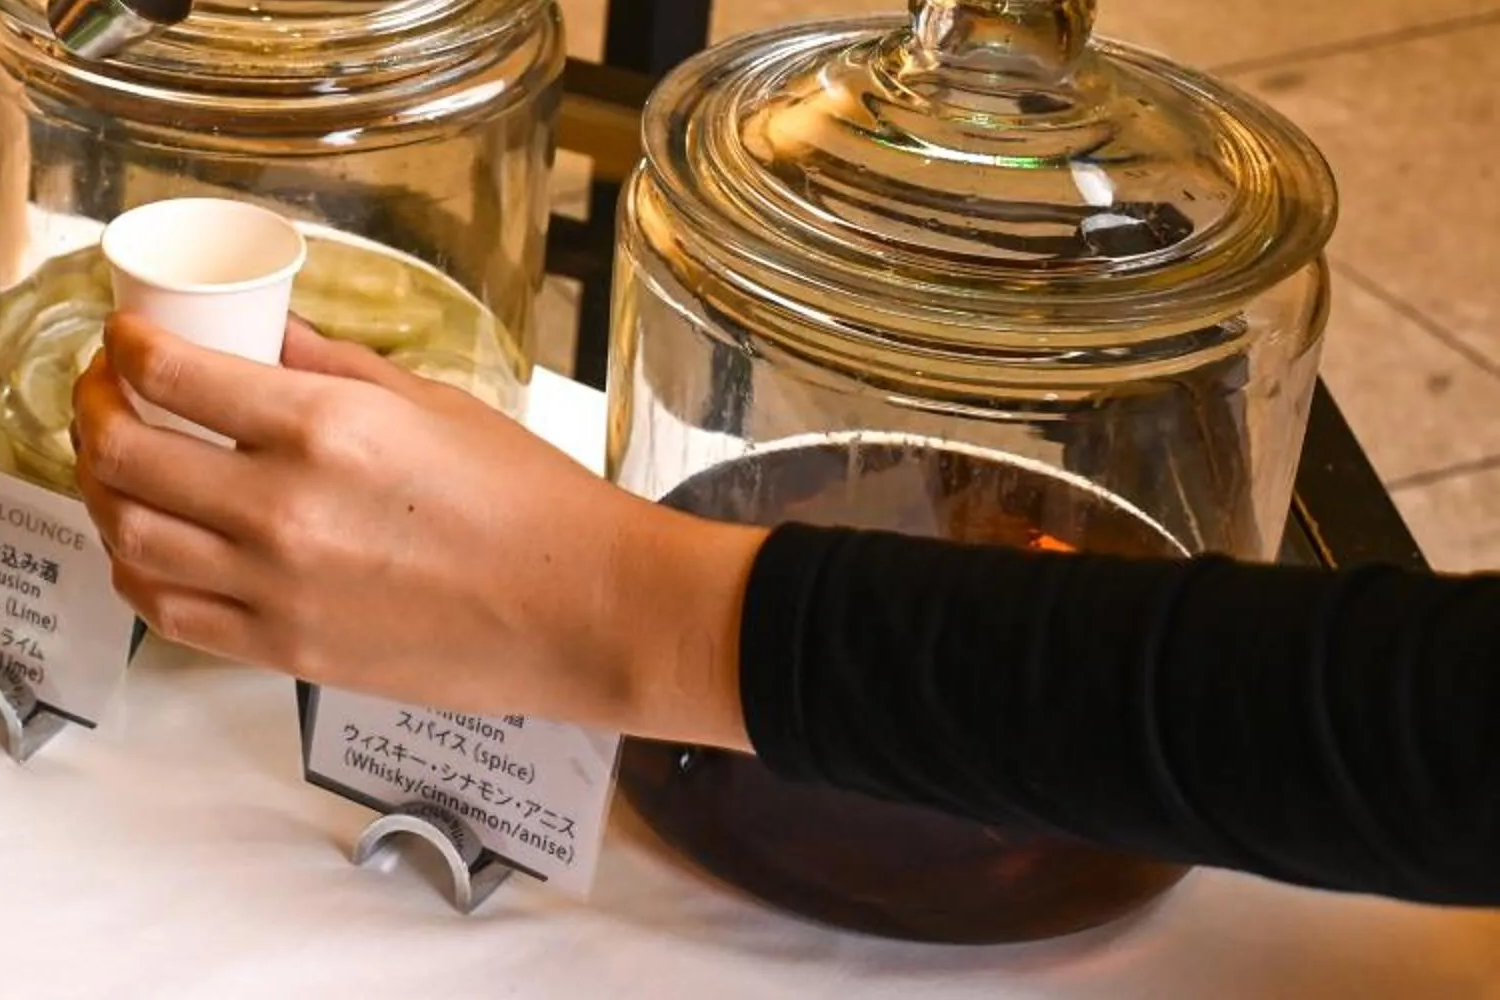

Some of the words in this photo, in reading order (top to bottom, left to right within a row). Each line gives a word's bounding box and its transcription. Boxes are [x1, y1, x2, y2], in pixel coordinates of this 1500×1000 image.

[5, 597, 57, 633] (Lime)
[395, 710, 466, 755] スパイス
[473, 742, 535, 784] (spice)
[426, 707, 505, 742] usion
[344, 749, 576, 865] (Whisky/cinnamon/anise)
